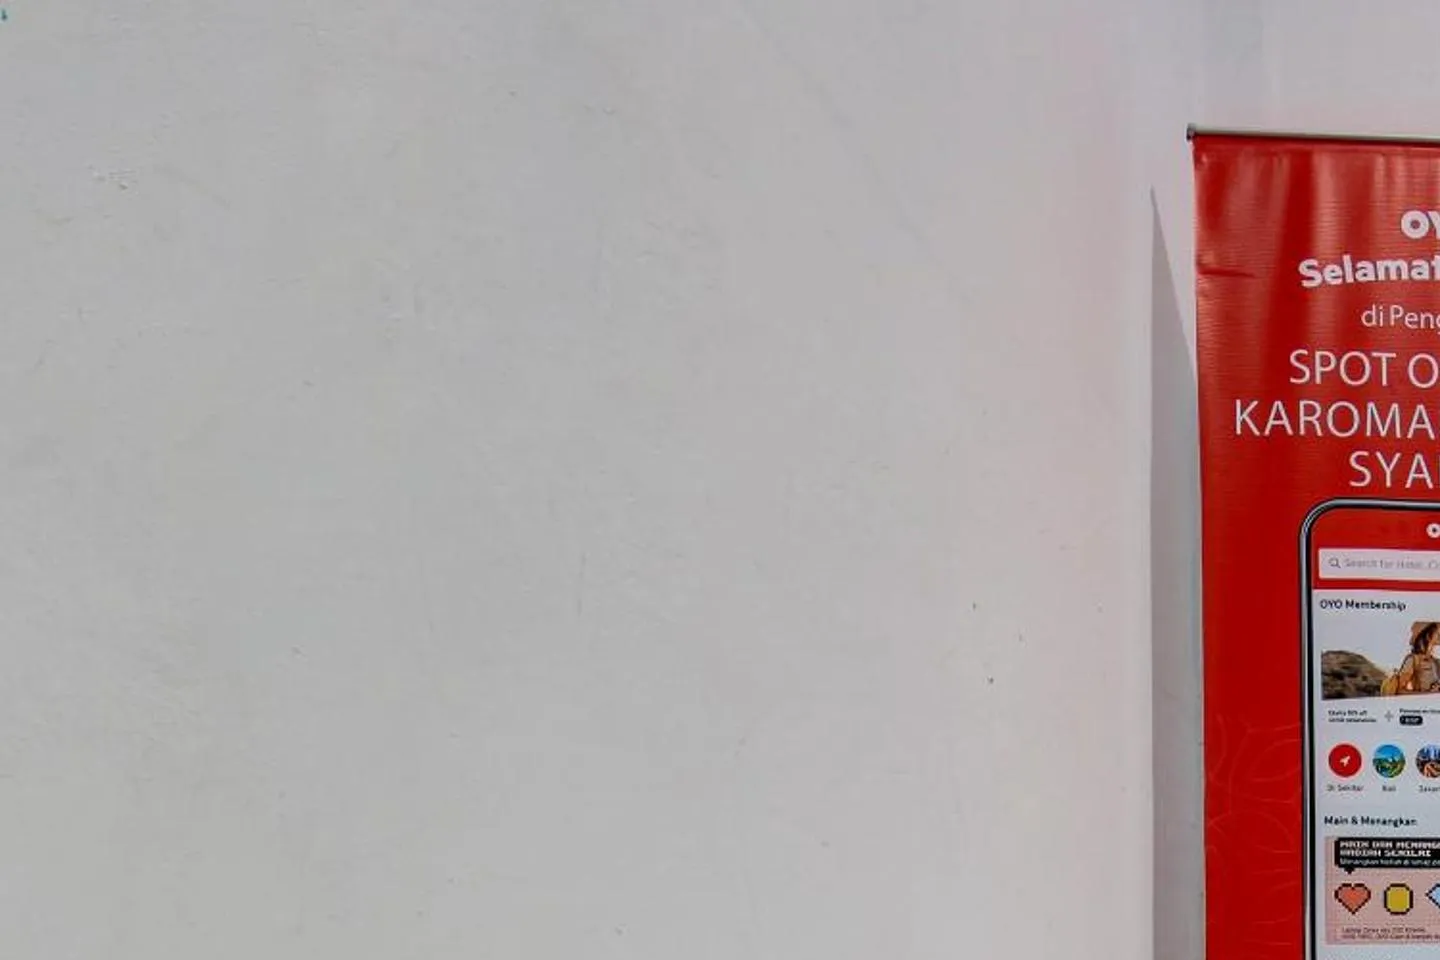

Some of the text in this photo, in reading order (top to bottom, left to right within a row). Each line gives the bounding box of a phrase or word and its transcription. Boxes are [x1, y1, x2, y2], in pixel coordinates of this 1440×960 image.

[1361, 305, 1384, 328] di
[1289, 349, 1396, 387] SPOT
[1320, 599, 1406, 612] OYO Membership
[1324, 815, 1349, 826] Main
[1361, 816, 1418, 828] Menangkan
